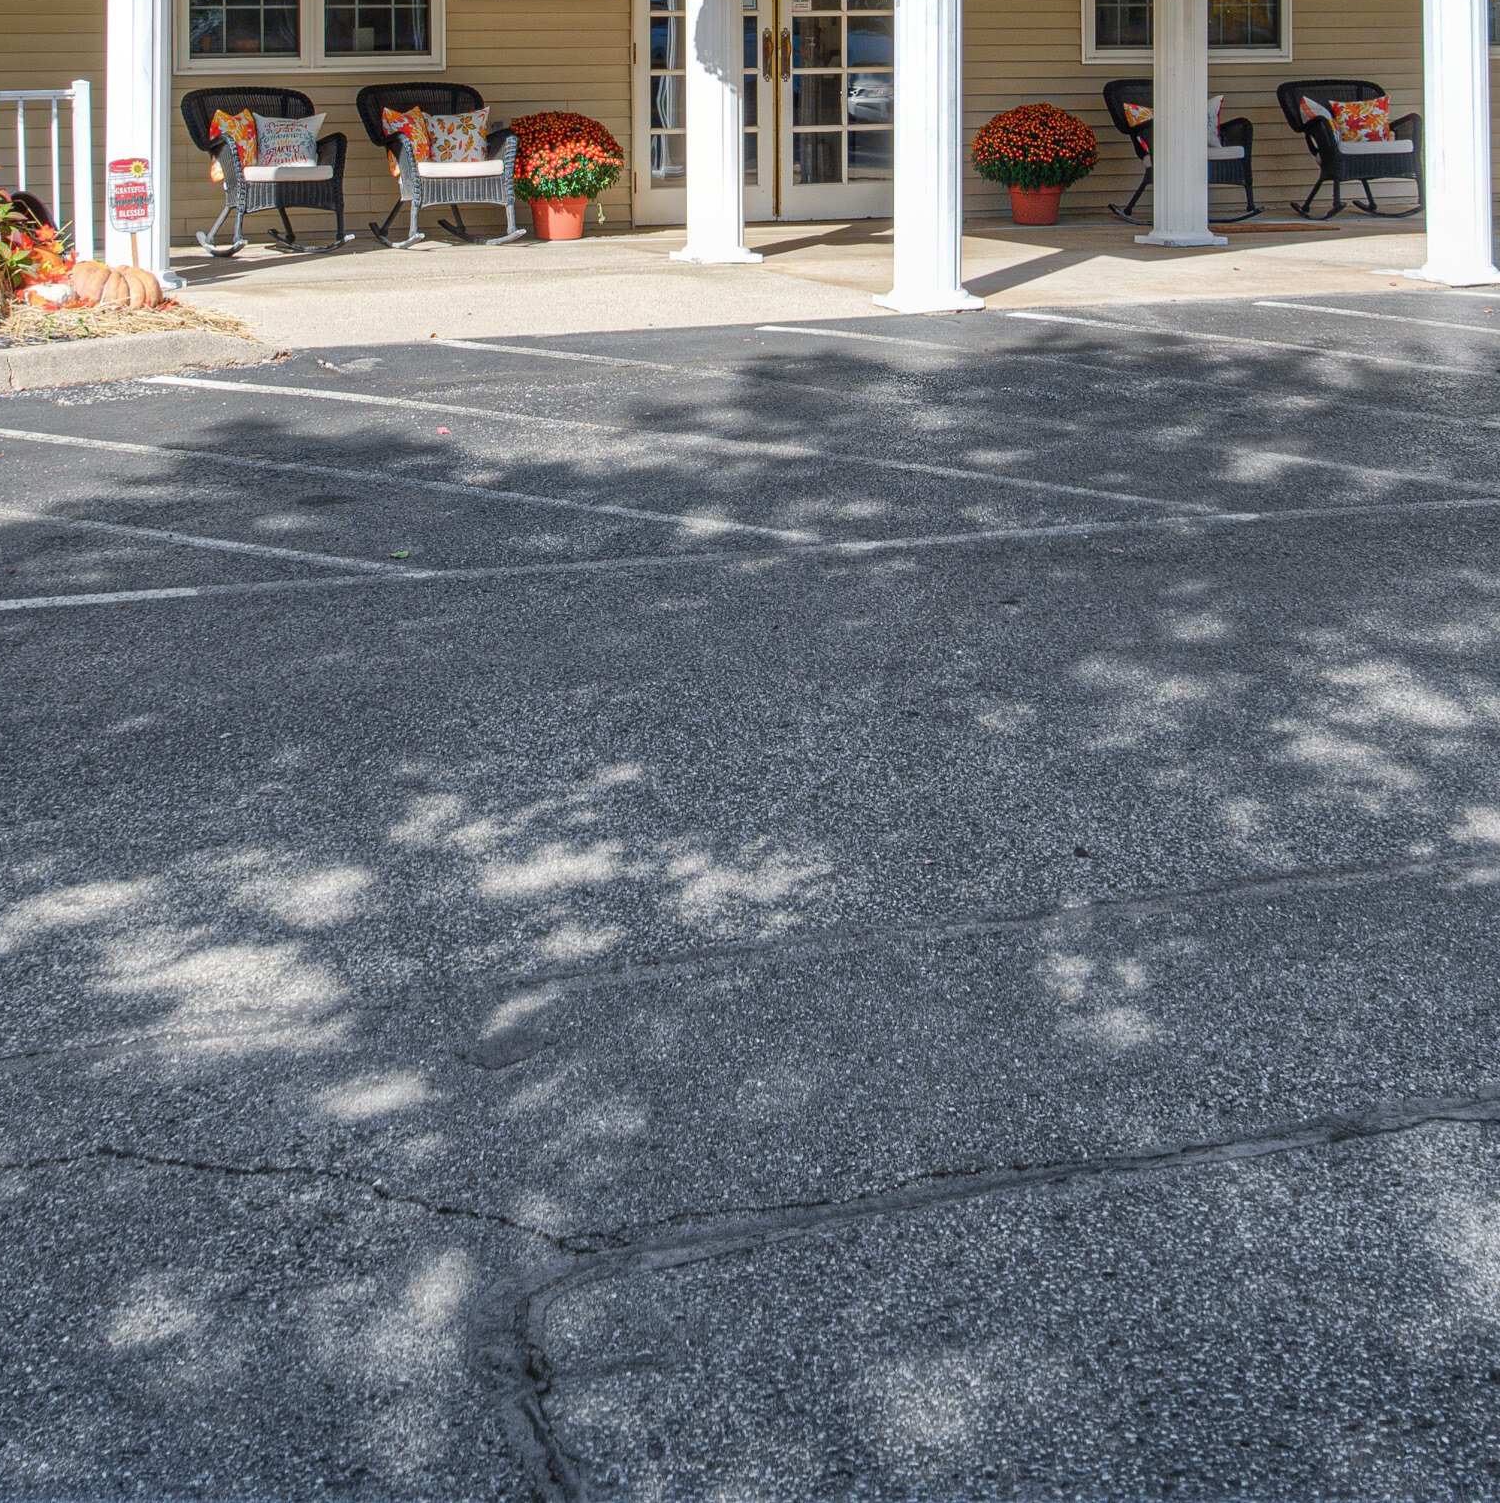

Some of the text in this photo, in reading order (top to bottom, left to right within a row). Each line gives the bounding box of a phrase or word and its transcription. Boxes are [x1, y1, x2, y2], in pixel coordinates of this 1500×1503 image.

[262, 148, 308, 166] Family
[115, 186, 146, 194] GRATEFUL
[119, 208, 146, 217] BLESSED
